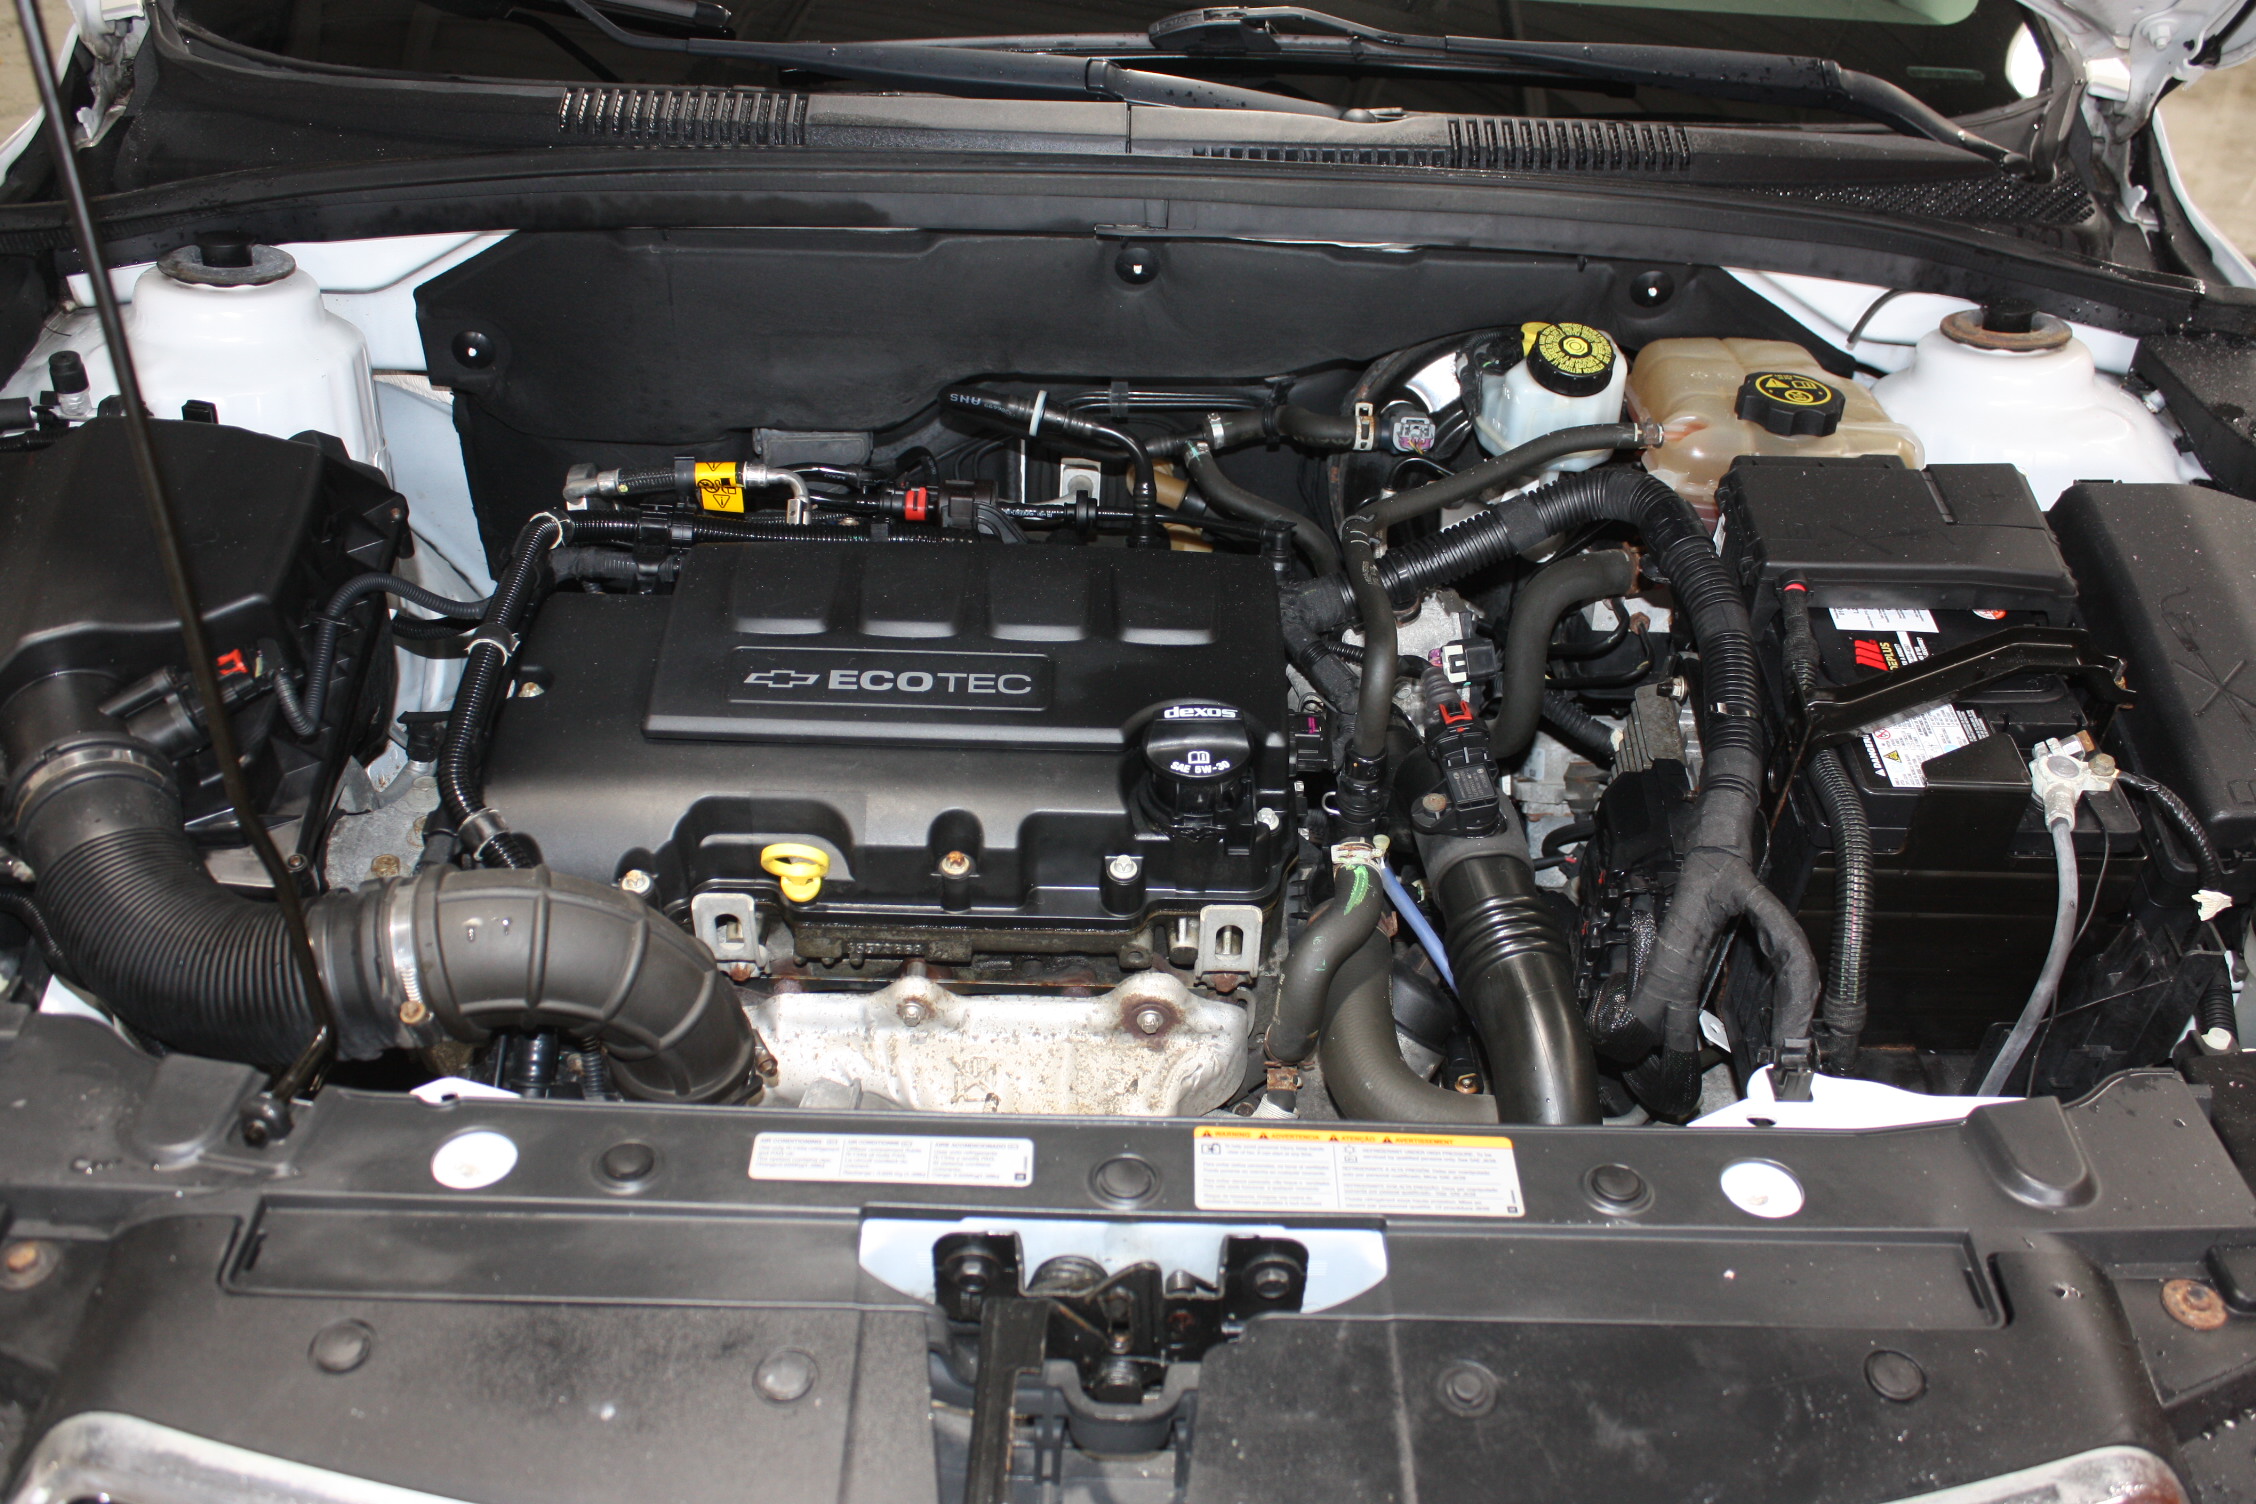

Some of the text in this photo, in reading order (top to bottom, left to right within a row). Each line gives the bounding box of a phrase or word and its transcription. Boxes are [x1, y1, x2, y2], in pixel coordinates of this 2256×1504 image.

[827, 669, 1032, 695] ECOTEC
[1163, 705, 1238, 719] dexos
[1170, 760, 1231, 774] SAE 5W-30
[1214, 1130, 1251, 1139] WARNING
[1270, 1132, 1320, 1141] ADVERTENCIA
